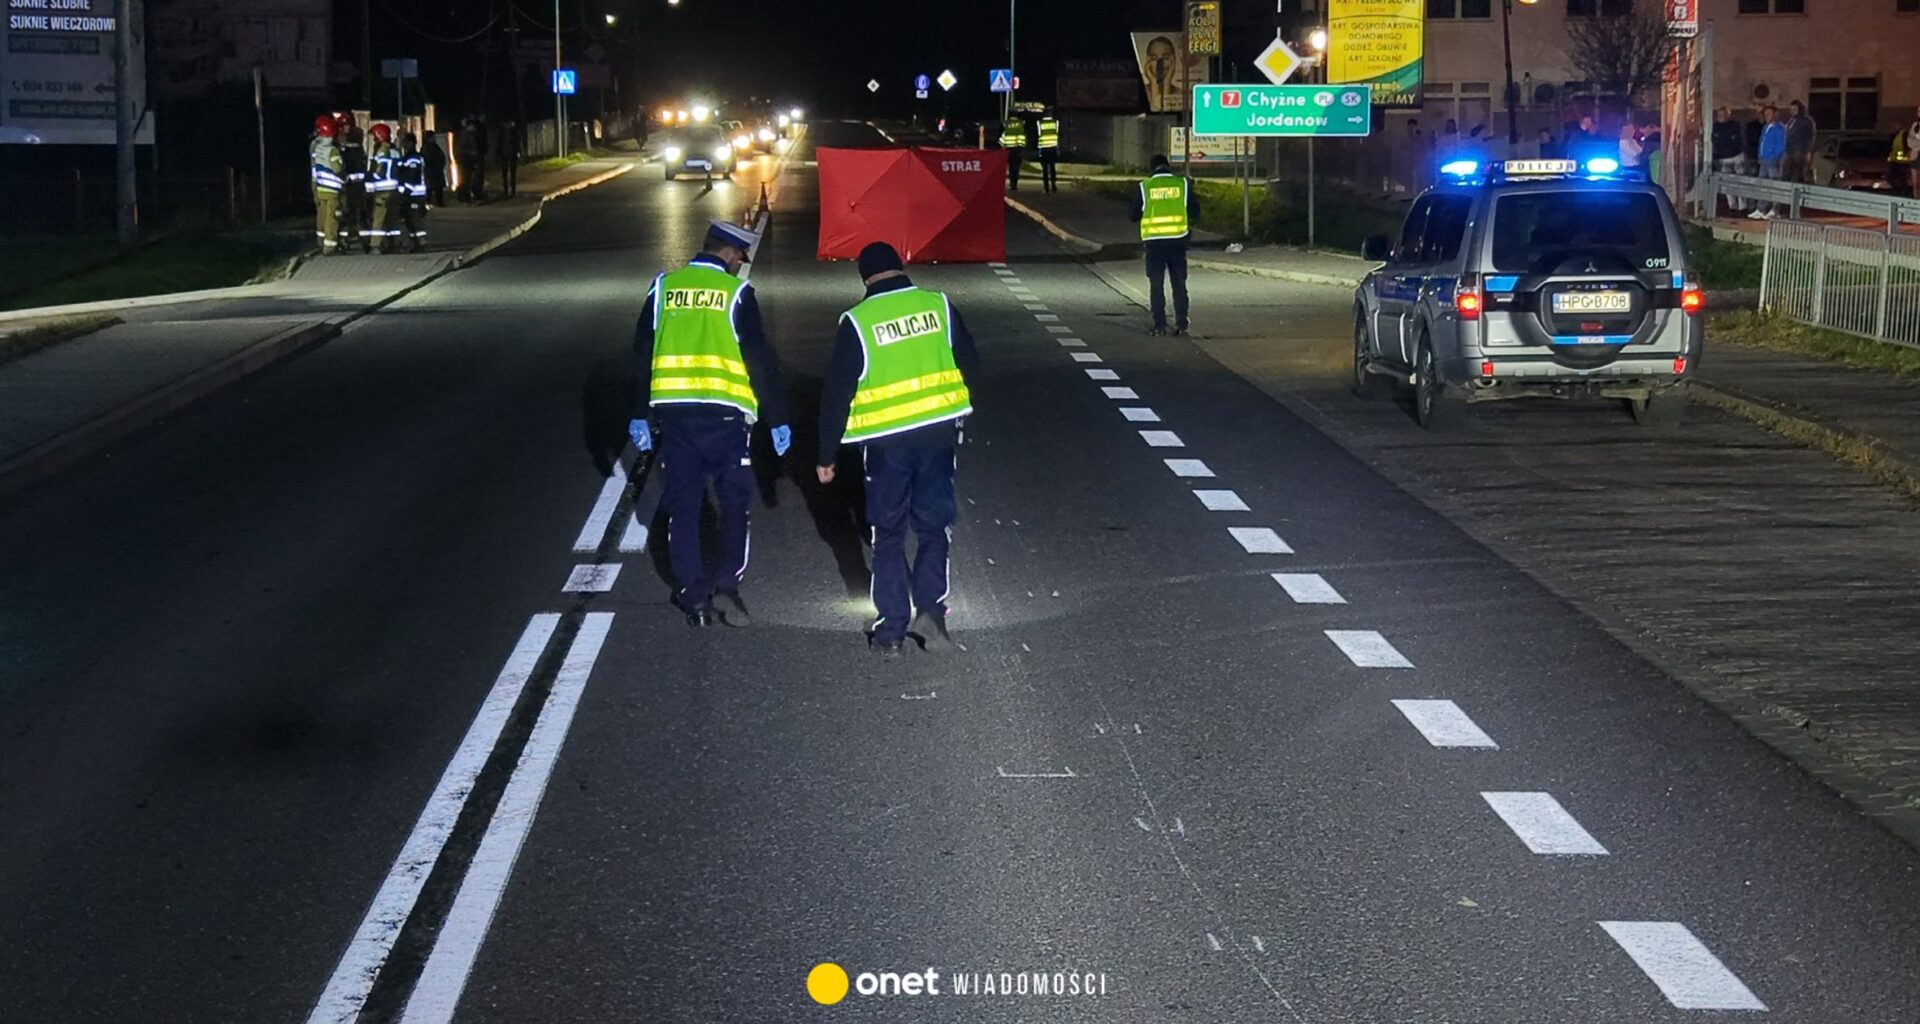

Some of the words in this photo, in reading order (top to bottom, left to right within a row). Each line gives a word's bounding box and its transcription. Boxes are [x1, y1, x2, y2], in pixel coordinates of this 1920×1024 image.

[10, 15, 48, 29] SUKNIE
[1351, 22, 1420, 30] GOSPODARSTWA
[1227, 93, 1235, 105] 7
[1247, 91, 1306, 109] Chyżne
[1318, 94, 1330, 104] PL
[1344, 94, 1357, 104] SK
[1371, 93, 1416, 105] SZAMY
[1246, 113, 1328, 127] Jordanów
[1506, 161, 1575, 171] POLICJA
[665, 288, 725, 309] POLICJA
[1562, 295, 1590, 308] HPG
[1594, 295, 1627, 308] B708
[875, 311, 940, 344] POLICJA
